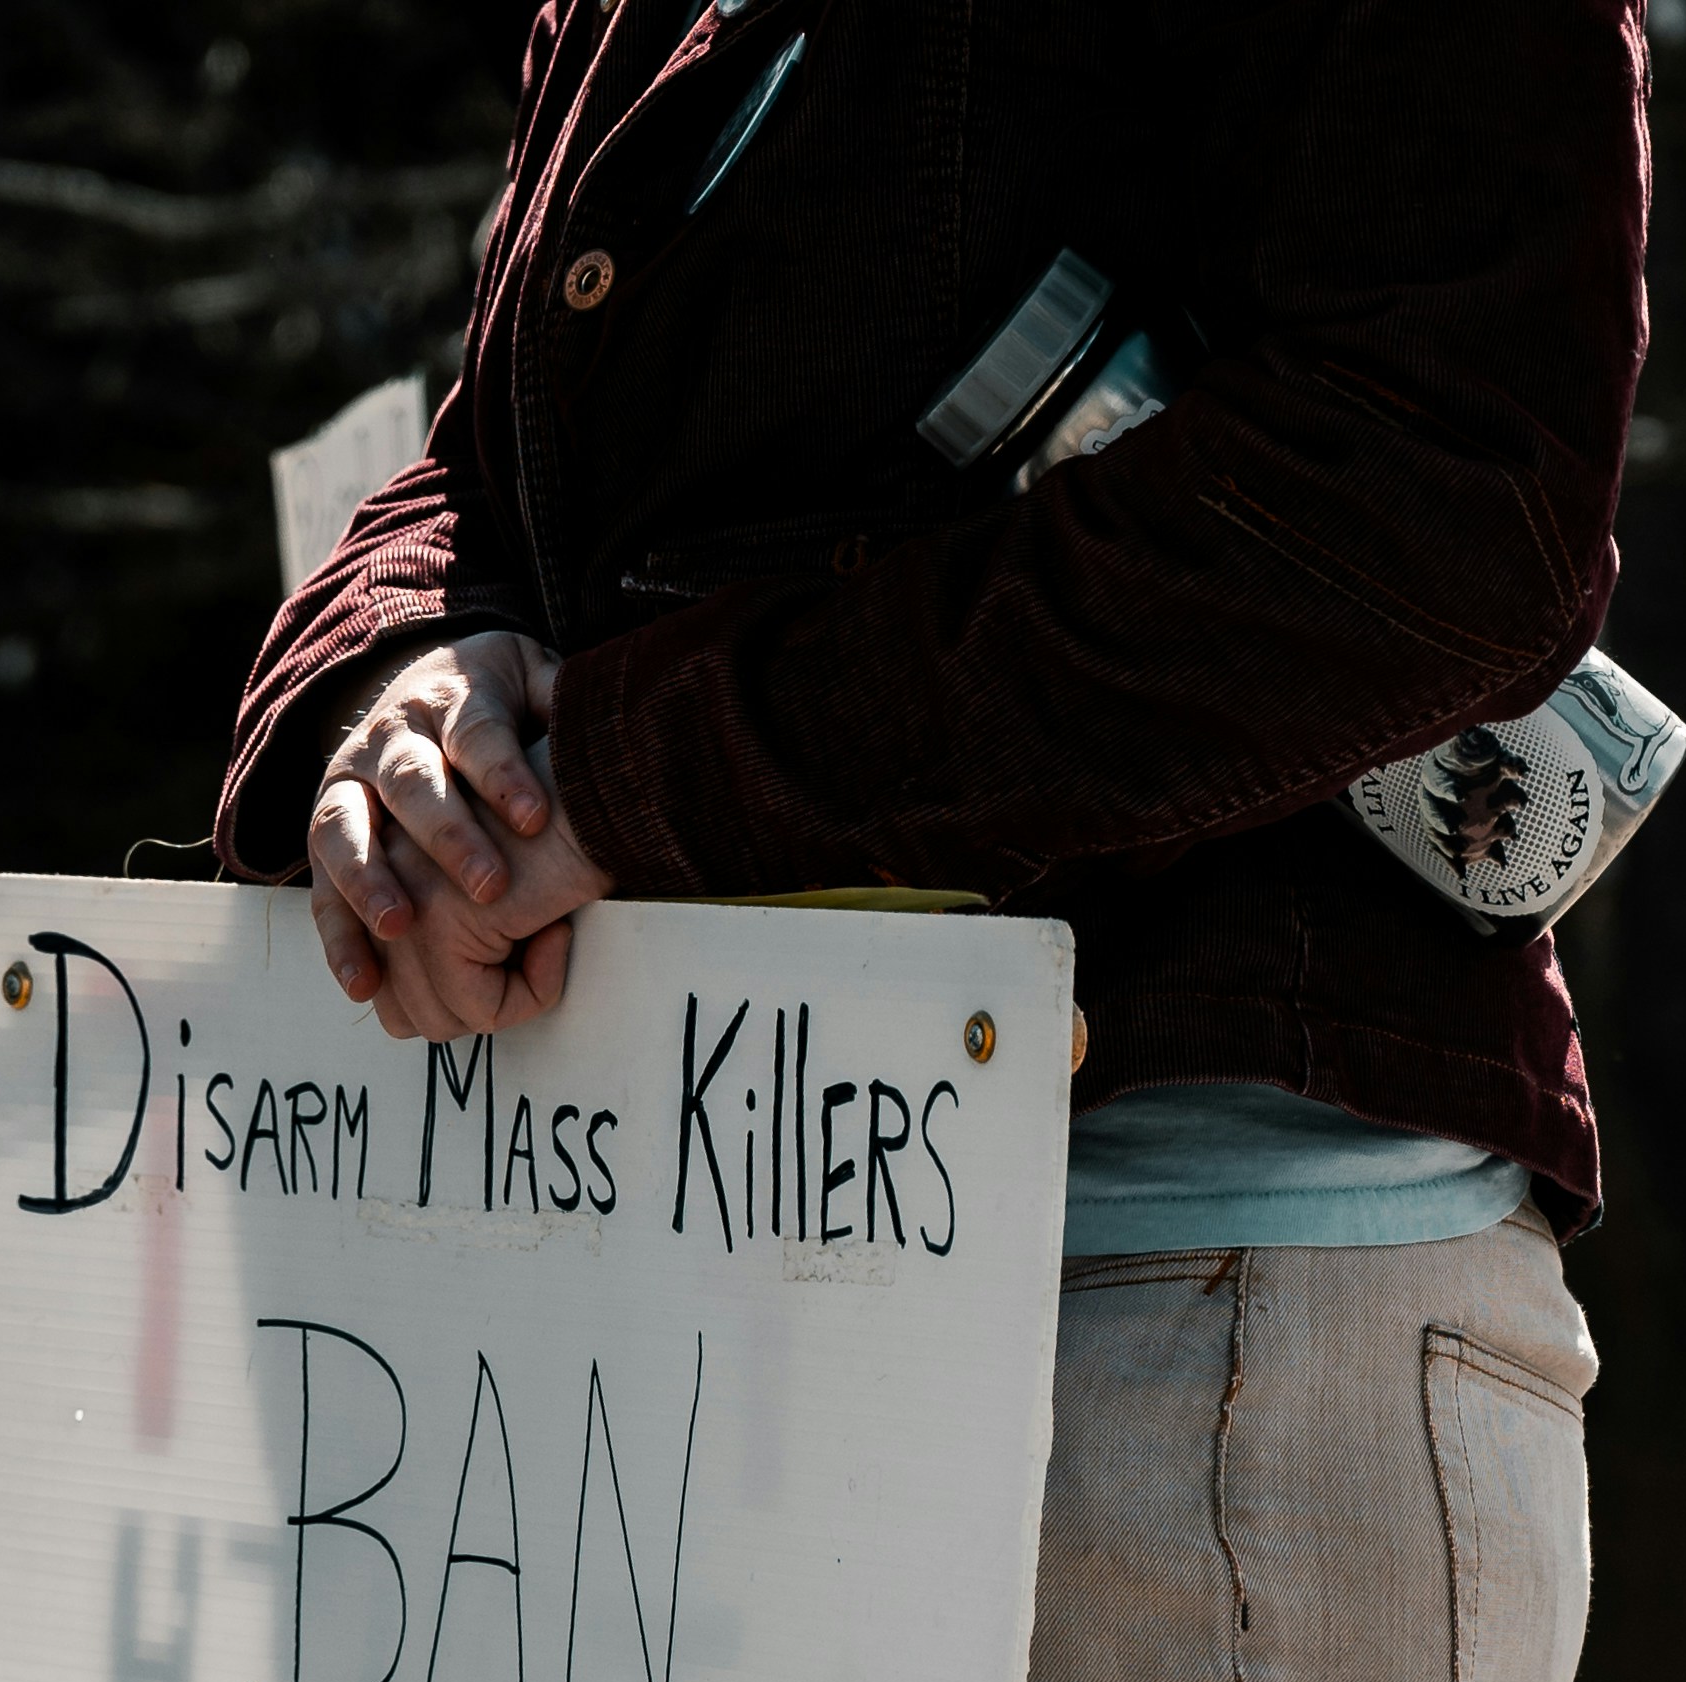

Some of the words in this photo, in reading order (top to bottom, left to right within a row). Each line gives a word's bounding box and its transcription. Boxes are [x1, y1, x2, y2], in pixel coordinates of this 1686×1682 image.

[1361, 764, 1388, 818] LIV
[1460, 883, 1472, 898] I
[1481, 873, 1551, 906] LIVE
[1550, 767, 1591, 880] AGAIN
[417, 1033, 618, 1214] MASS
